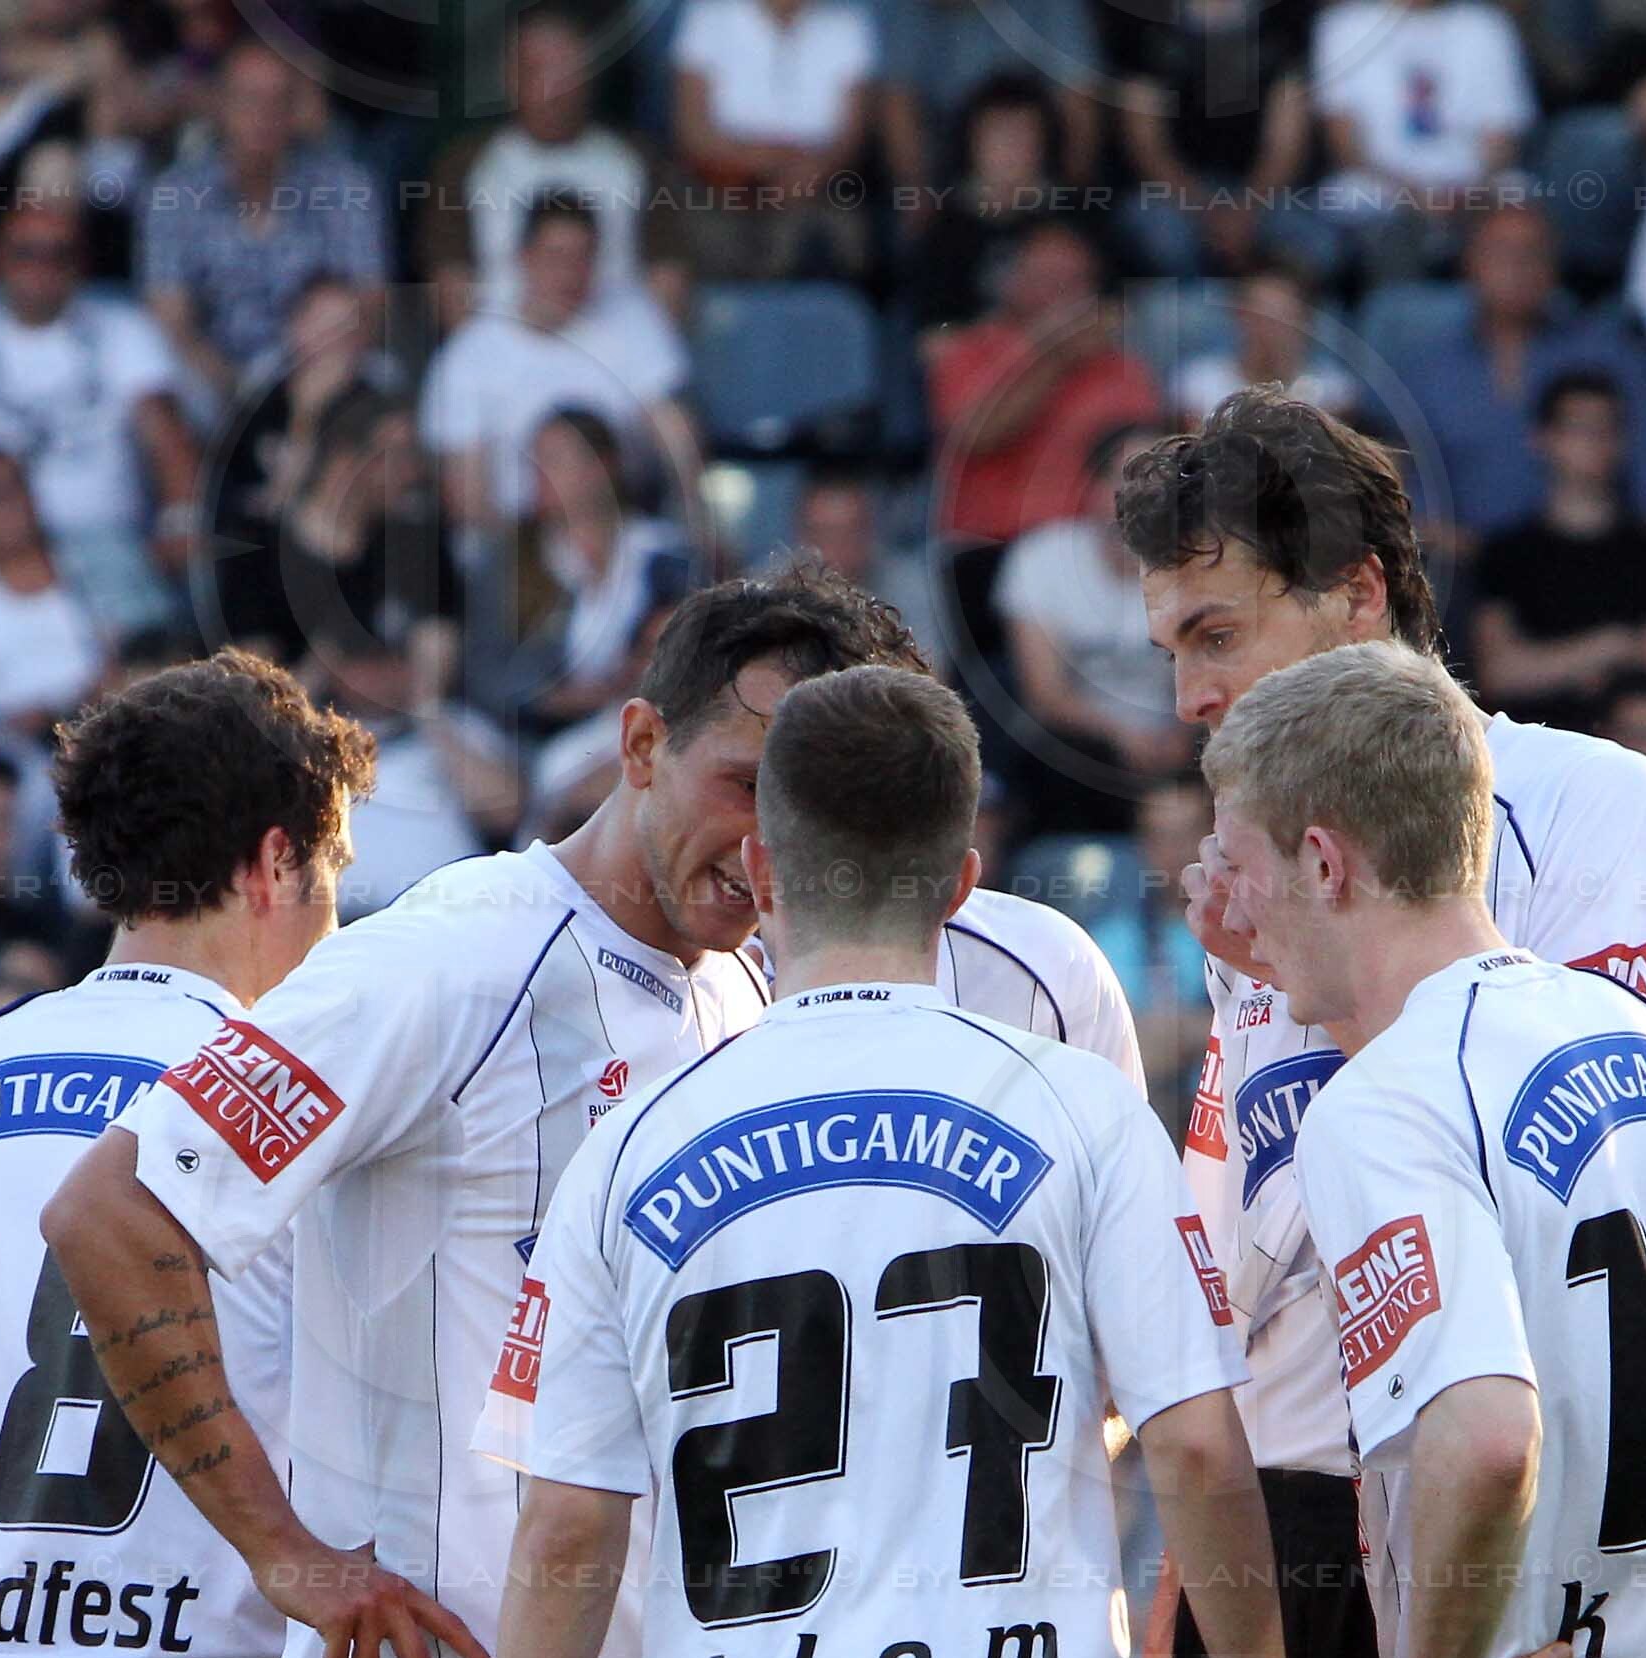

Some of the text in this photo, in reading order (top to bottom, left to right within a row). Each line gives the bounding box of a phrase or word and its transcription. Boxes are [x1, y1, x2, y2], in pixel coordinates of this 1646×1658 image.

[857, 988, 892, 1002] GRAZ
[639, 1113, 1022, 1246] PUNTIGAMER
[664, 1243, 1063, 1630] 27
